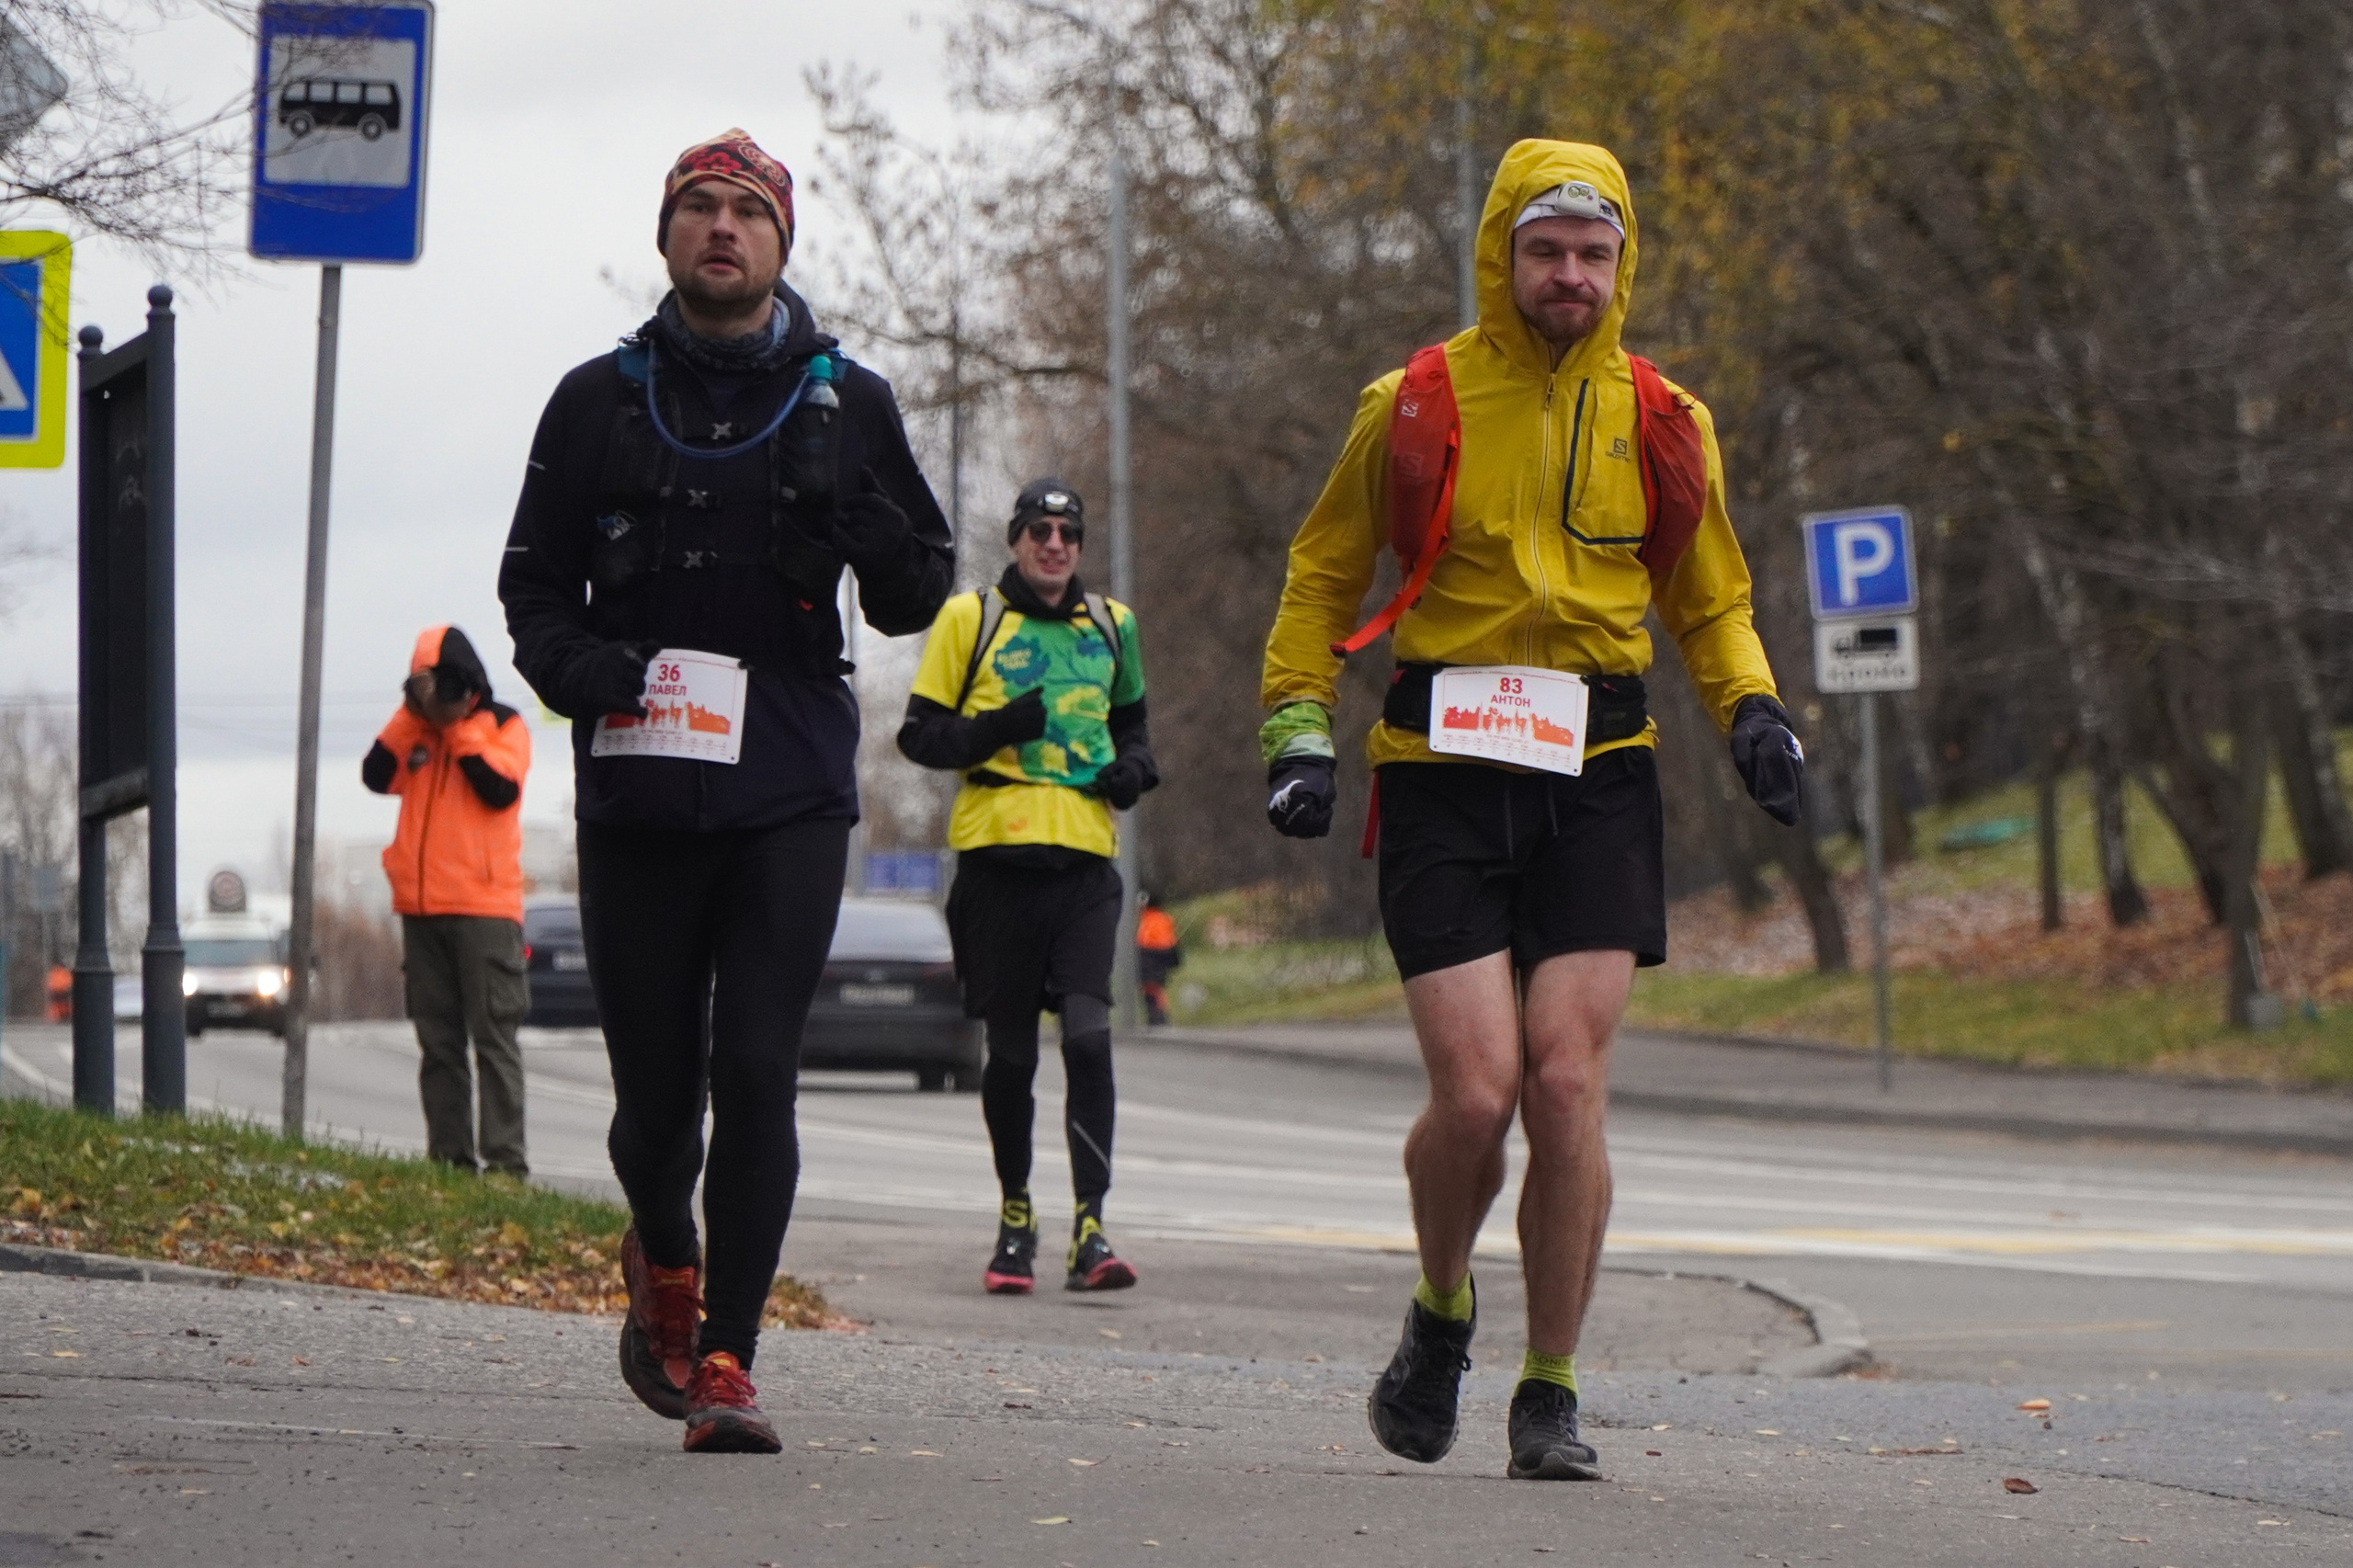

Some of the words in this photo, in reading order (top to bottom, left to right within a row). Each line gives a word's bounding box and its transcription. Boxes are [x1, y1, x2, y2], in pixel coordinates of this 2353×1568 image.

[1835, 522, 1894, 606] P
[657, 664, 680, 682] 36
[649, 684, 687, 697] ПАВЕЛ
[1499, 677, 1523, 694] 83
[1490, 694, 1531, 708] АНТОН
